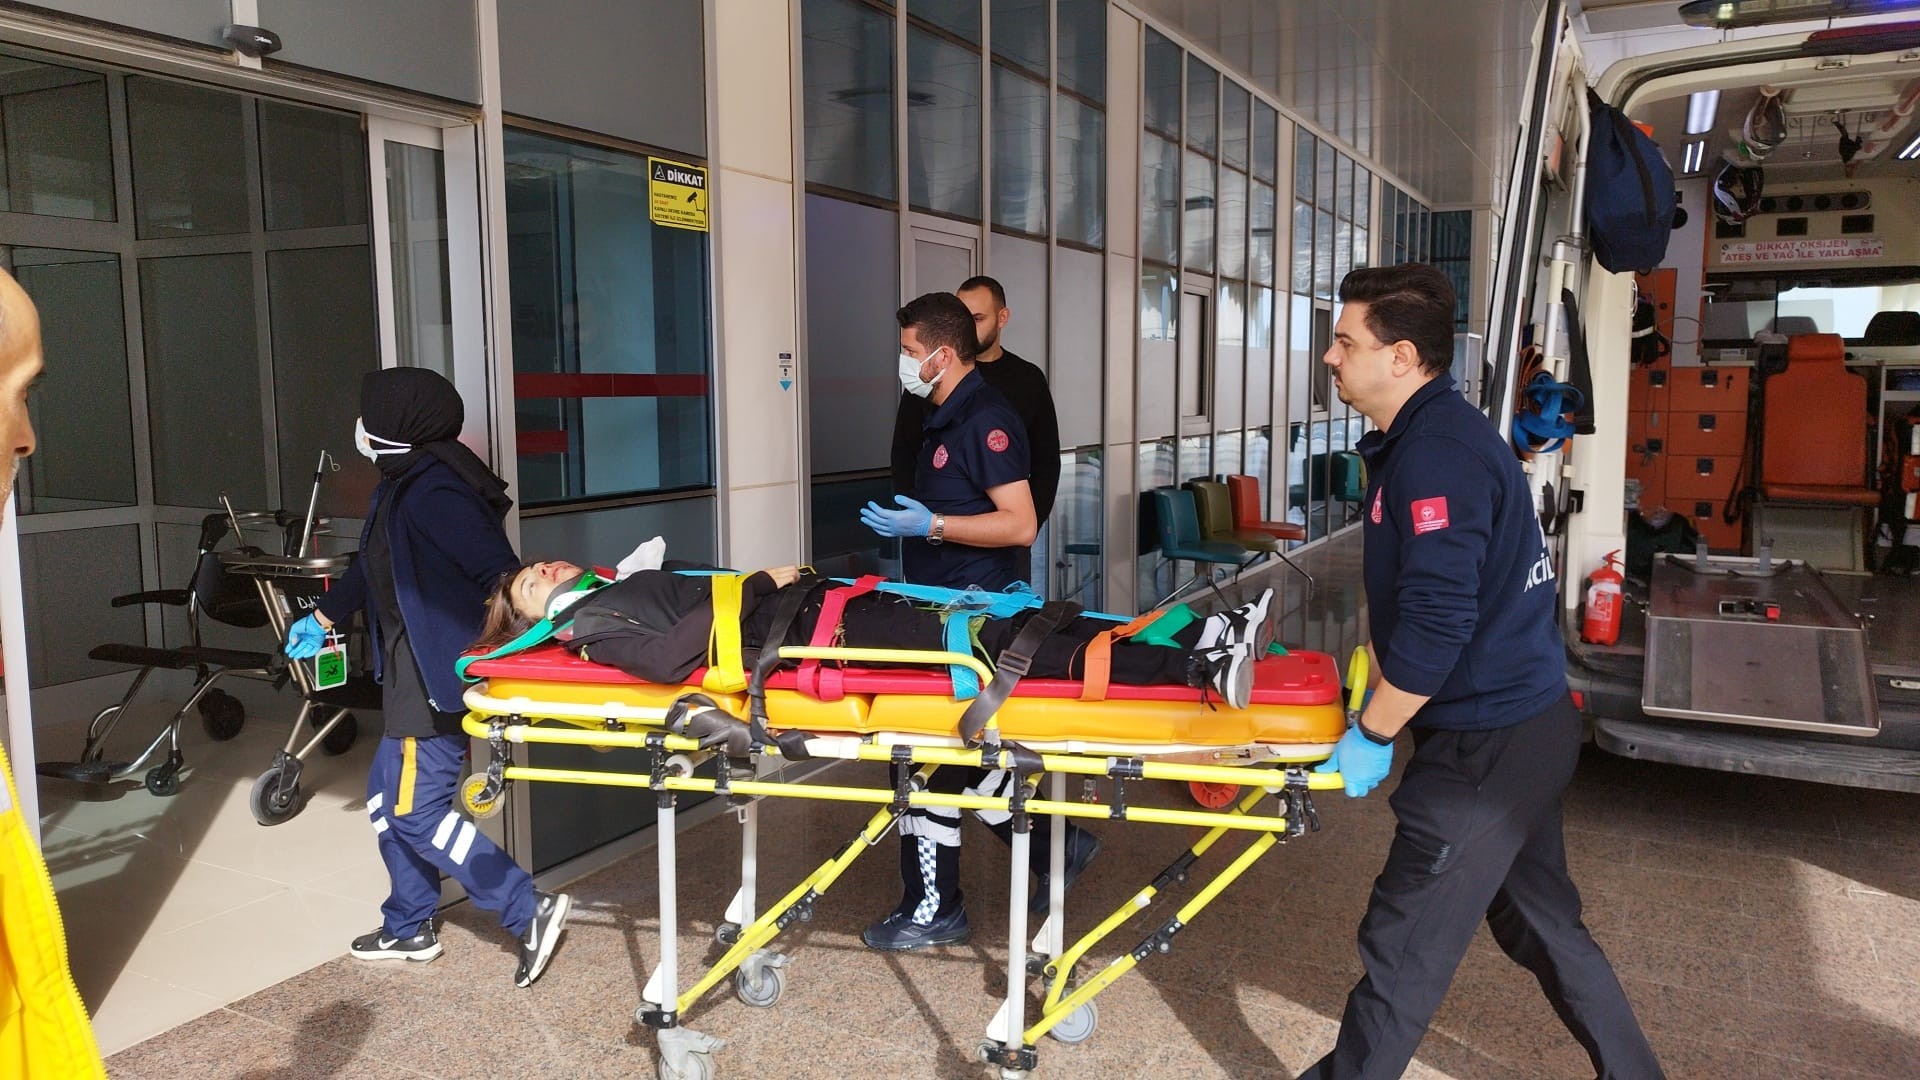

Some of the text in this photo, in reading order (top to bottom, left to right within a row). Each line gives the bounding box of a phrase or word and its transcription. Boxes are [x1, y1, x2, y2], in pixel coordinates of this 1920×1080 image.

[667, 169, 703, 187] DİKKAT
[1725, 252, 1752, 262] ATEŞ
[1755, 252, 1770, 261] VE
[1819, 247, 1880, 258] YAKLAŞMA
